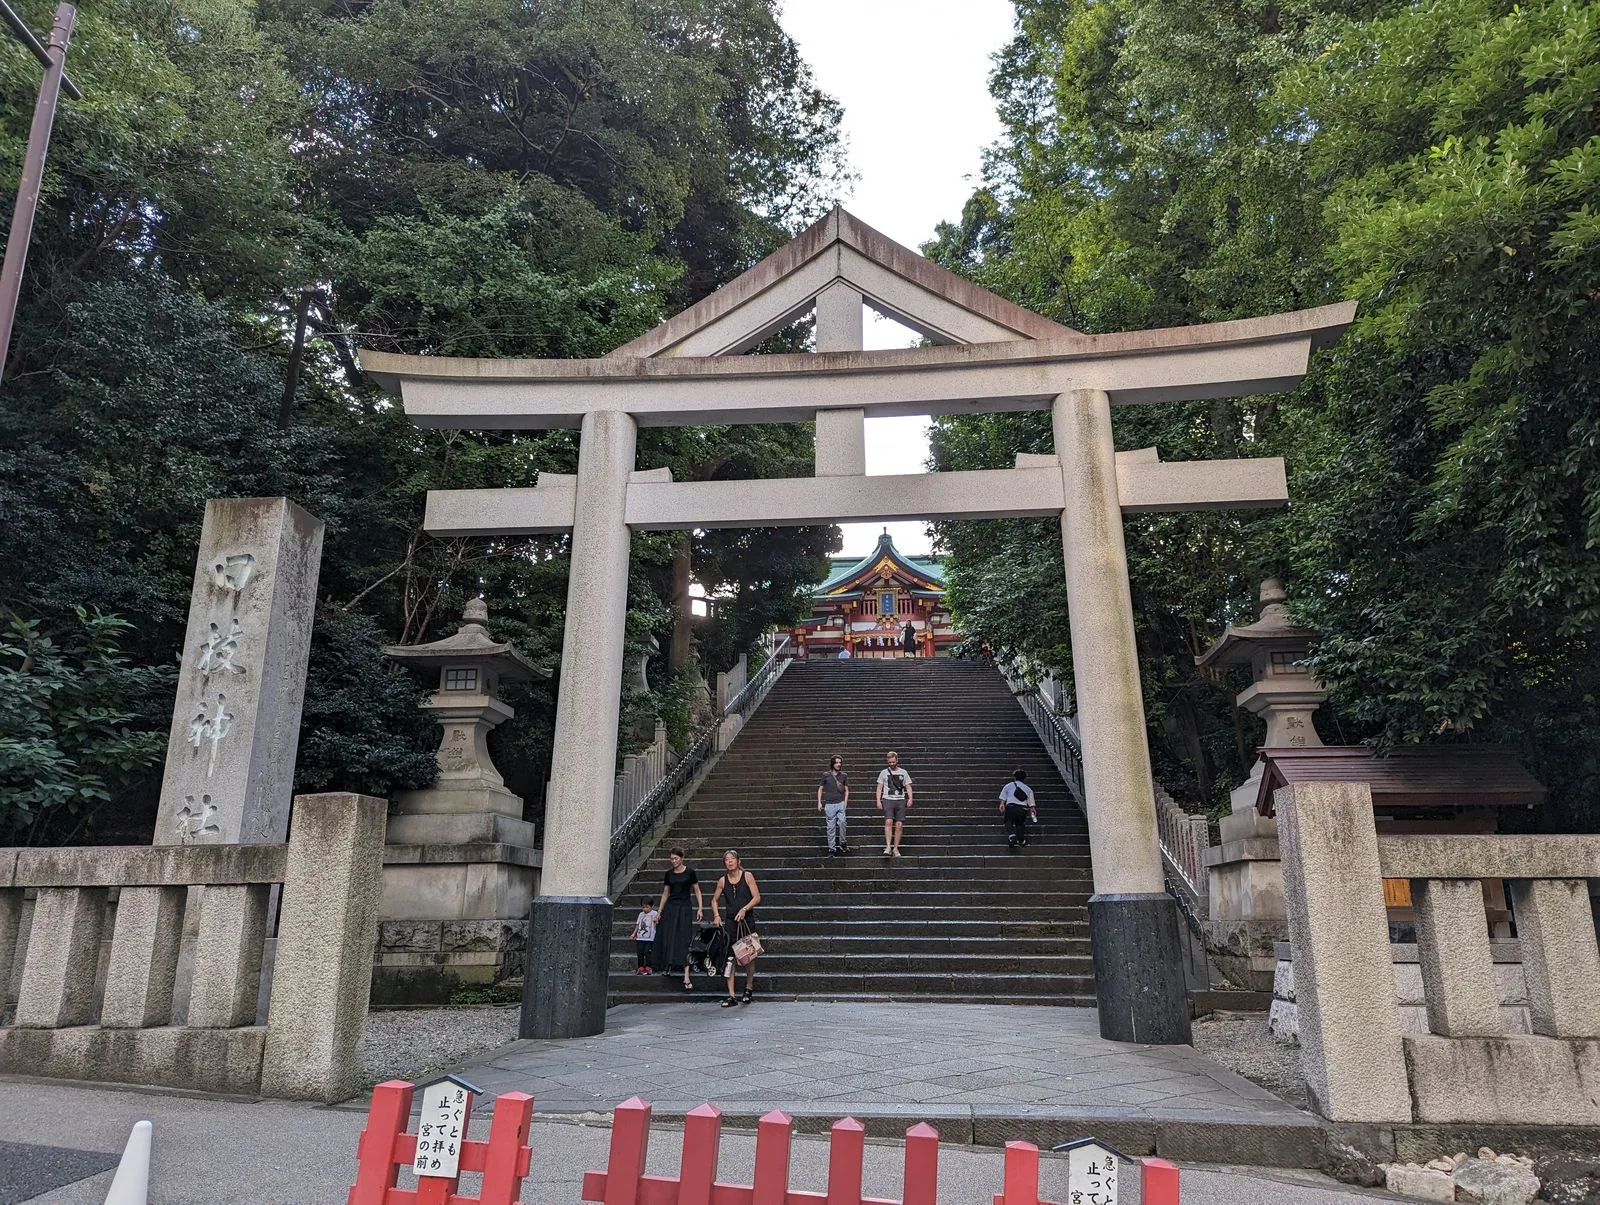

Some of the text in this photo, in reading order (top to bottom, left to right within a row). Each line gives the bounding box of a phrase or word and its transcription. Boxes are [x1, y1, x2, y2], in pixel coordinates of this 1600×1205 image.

[416, 1122, 433, 1169] 宮の前
[430, 1095, 451, 1170] 止って拝め
[447, 1089, 465, 1156] 急ぐとも
[1070, 1189, 1084, 1205] 宮
